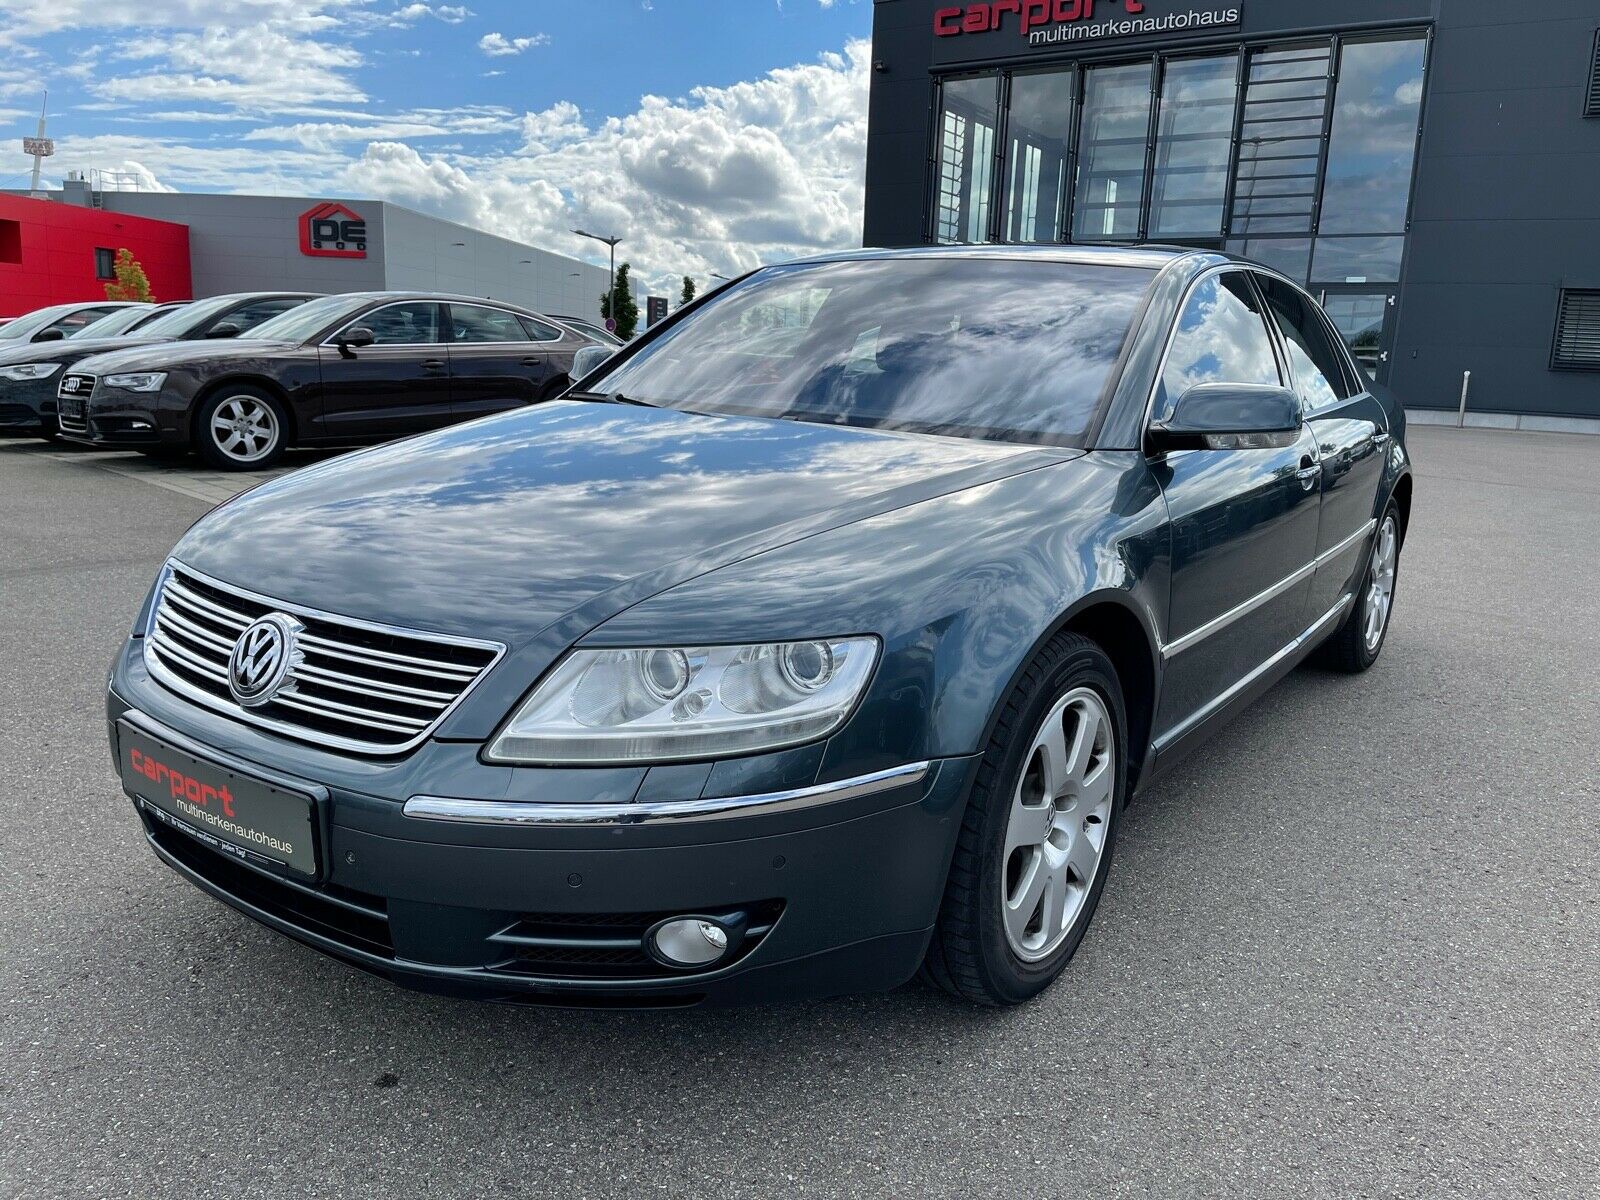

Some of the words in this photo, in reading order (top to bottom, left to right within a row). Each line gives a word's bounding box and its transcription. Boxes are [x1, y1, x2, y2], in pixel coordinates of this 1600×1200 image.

[1029, 7, 1239, 44] multimarkenautohaus
[234, 622, 282, 691] VW
[130, 749, 235, 817] carport
[176, 798, 293, 854] multimarkenautohaus
